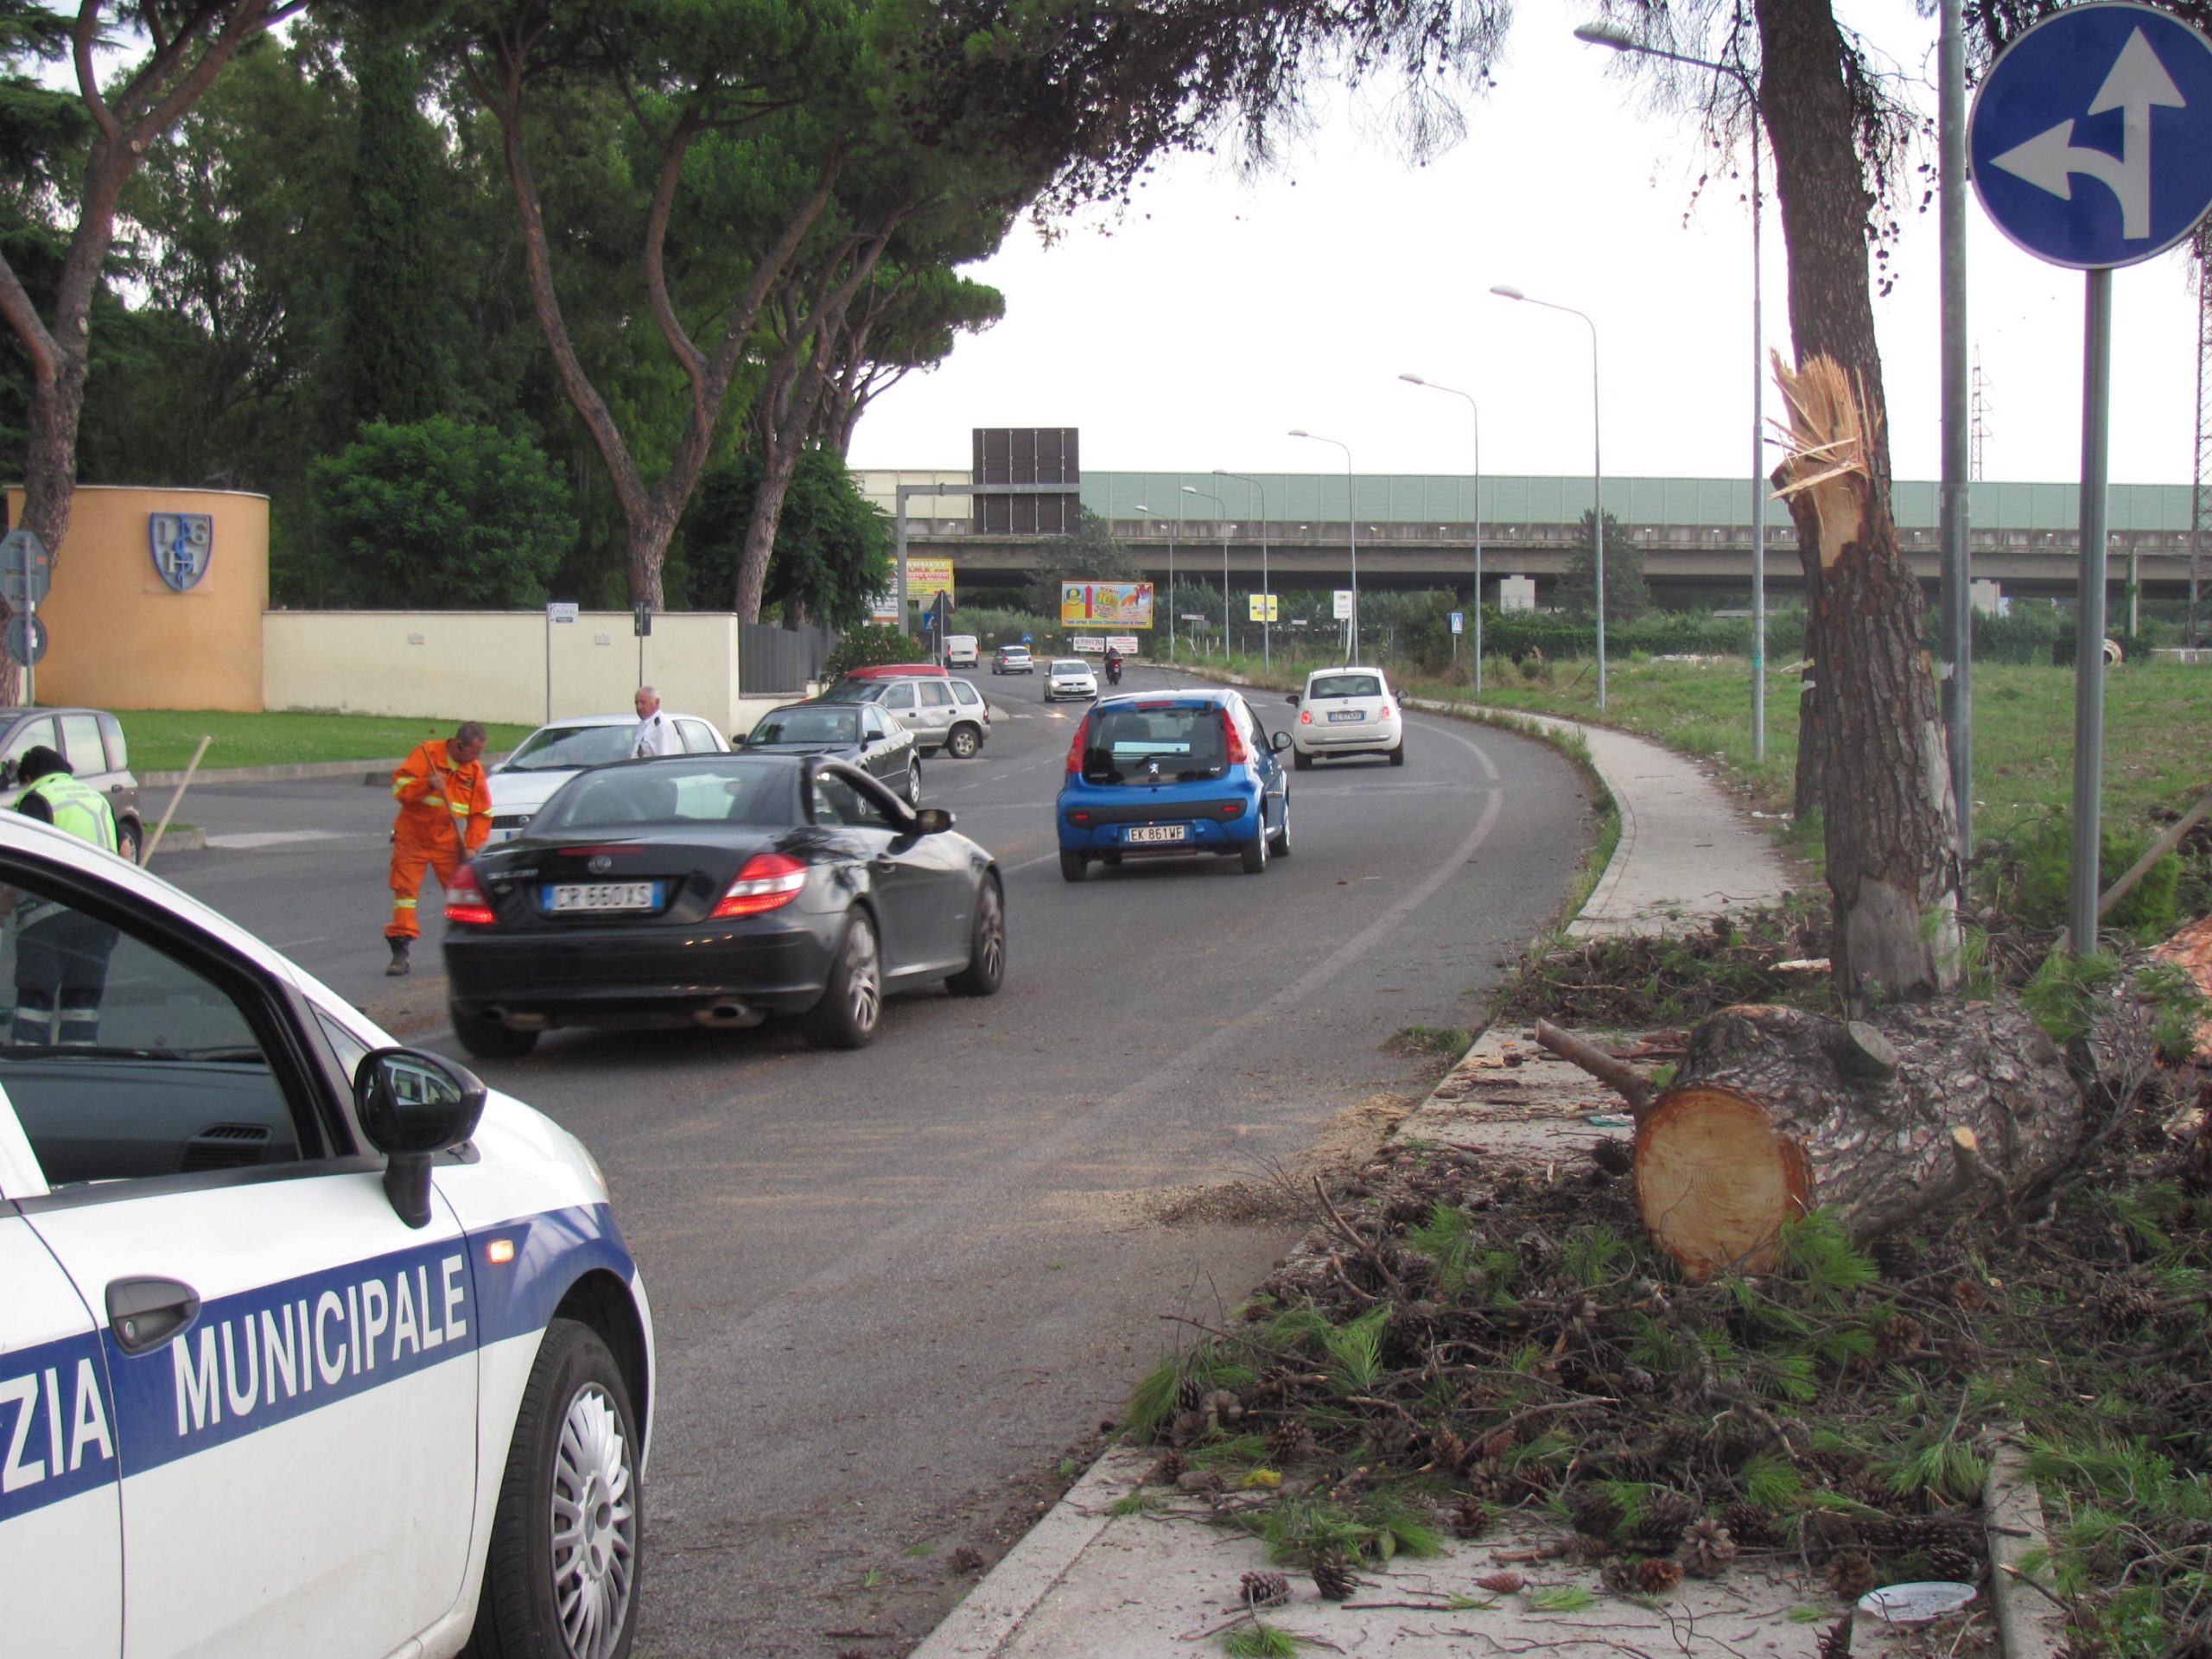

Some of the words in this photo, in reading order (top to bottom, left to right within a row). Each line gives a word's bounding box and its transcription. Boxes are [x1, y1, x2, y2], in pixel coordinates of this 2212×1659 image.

[1131, 829, 1144, 841] EK
[1148, 826, 1182, 840] 861WF
[0, 1357, 114, 1494] ZIA
[173, 1254, 467, 1437] MUNICIPALE
